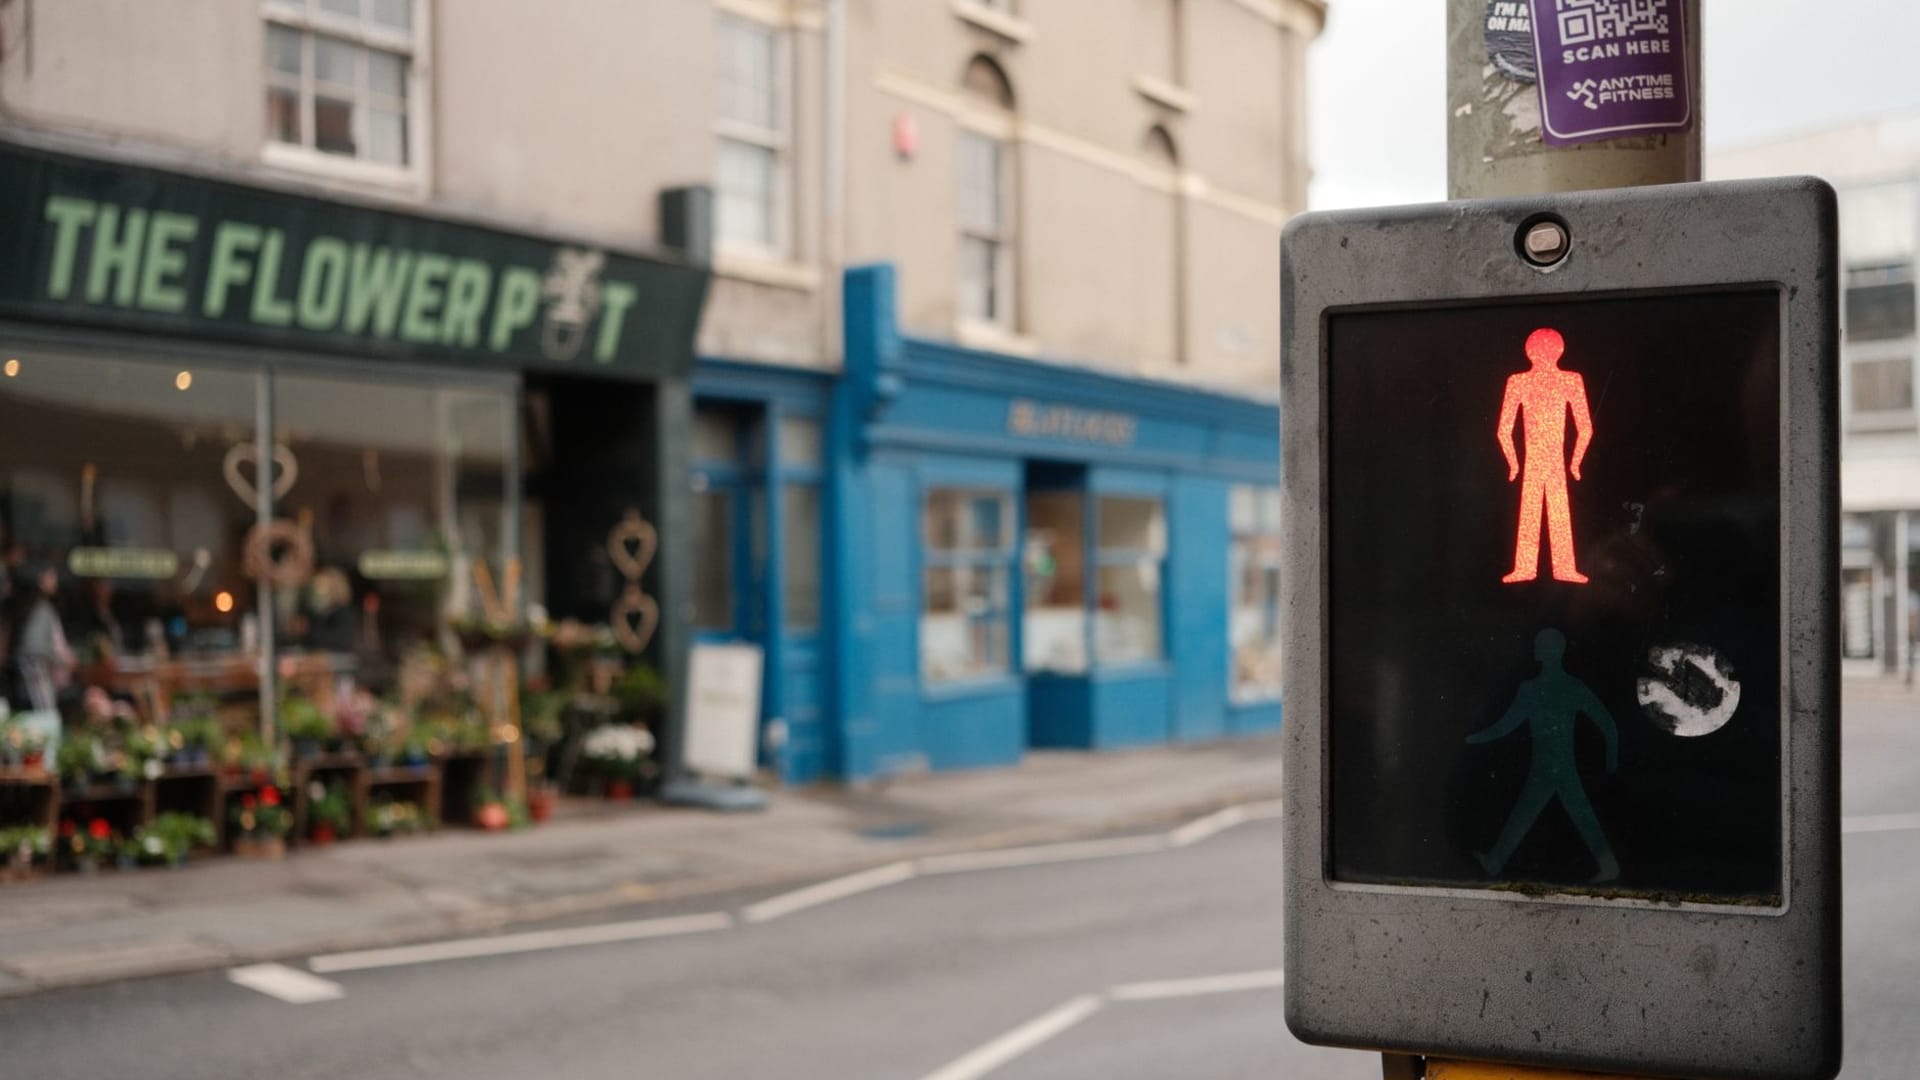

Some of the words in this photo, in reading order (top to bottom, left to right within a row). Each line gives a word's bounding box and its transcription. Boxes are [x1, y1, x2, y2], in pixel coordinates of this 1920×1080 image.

[1487, 16, 1508, 31] ON
[1562, 42, 1621, 64] SCAN
[1626, 39, 1671, 55] HERE
[1598, 74, 1673, 91] ANYTIME
[1598, 87, 1675, 104] FITNESS
[45, 197, 198, 313] THE
[202, 220, 493, 349] FLOWER
